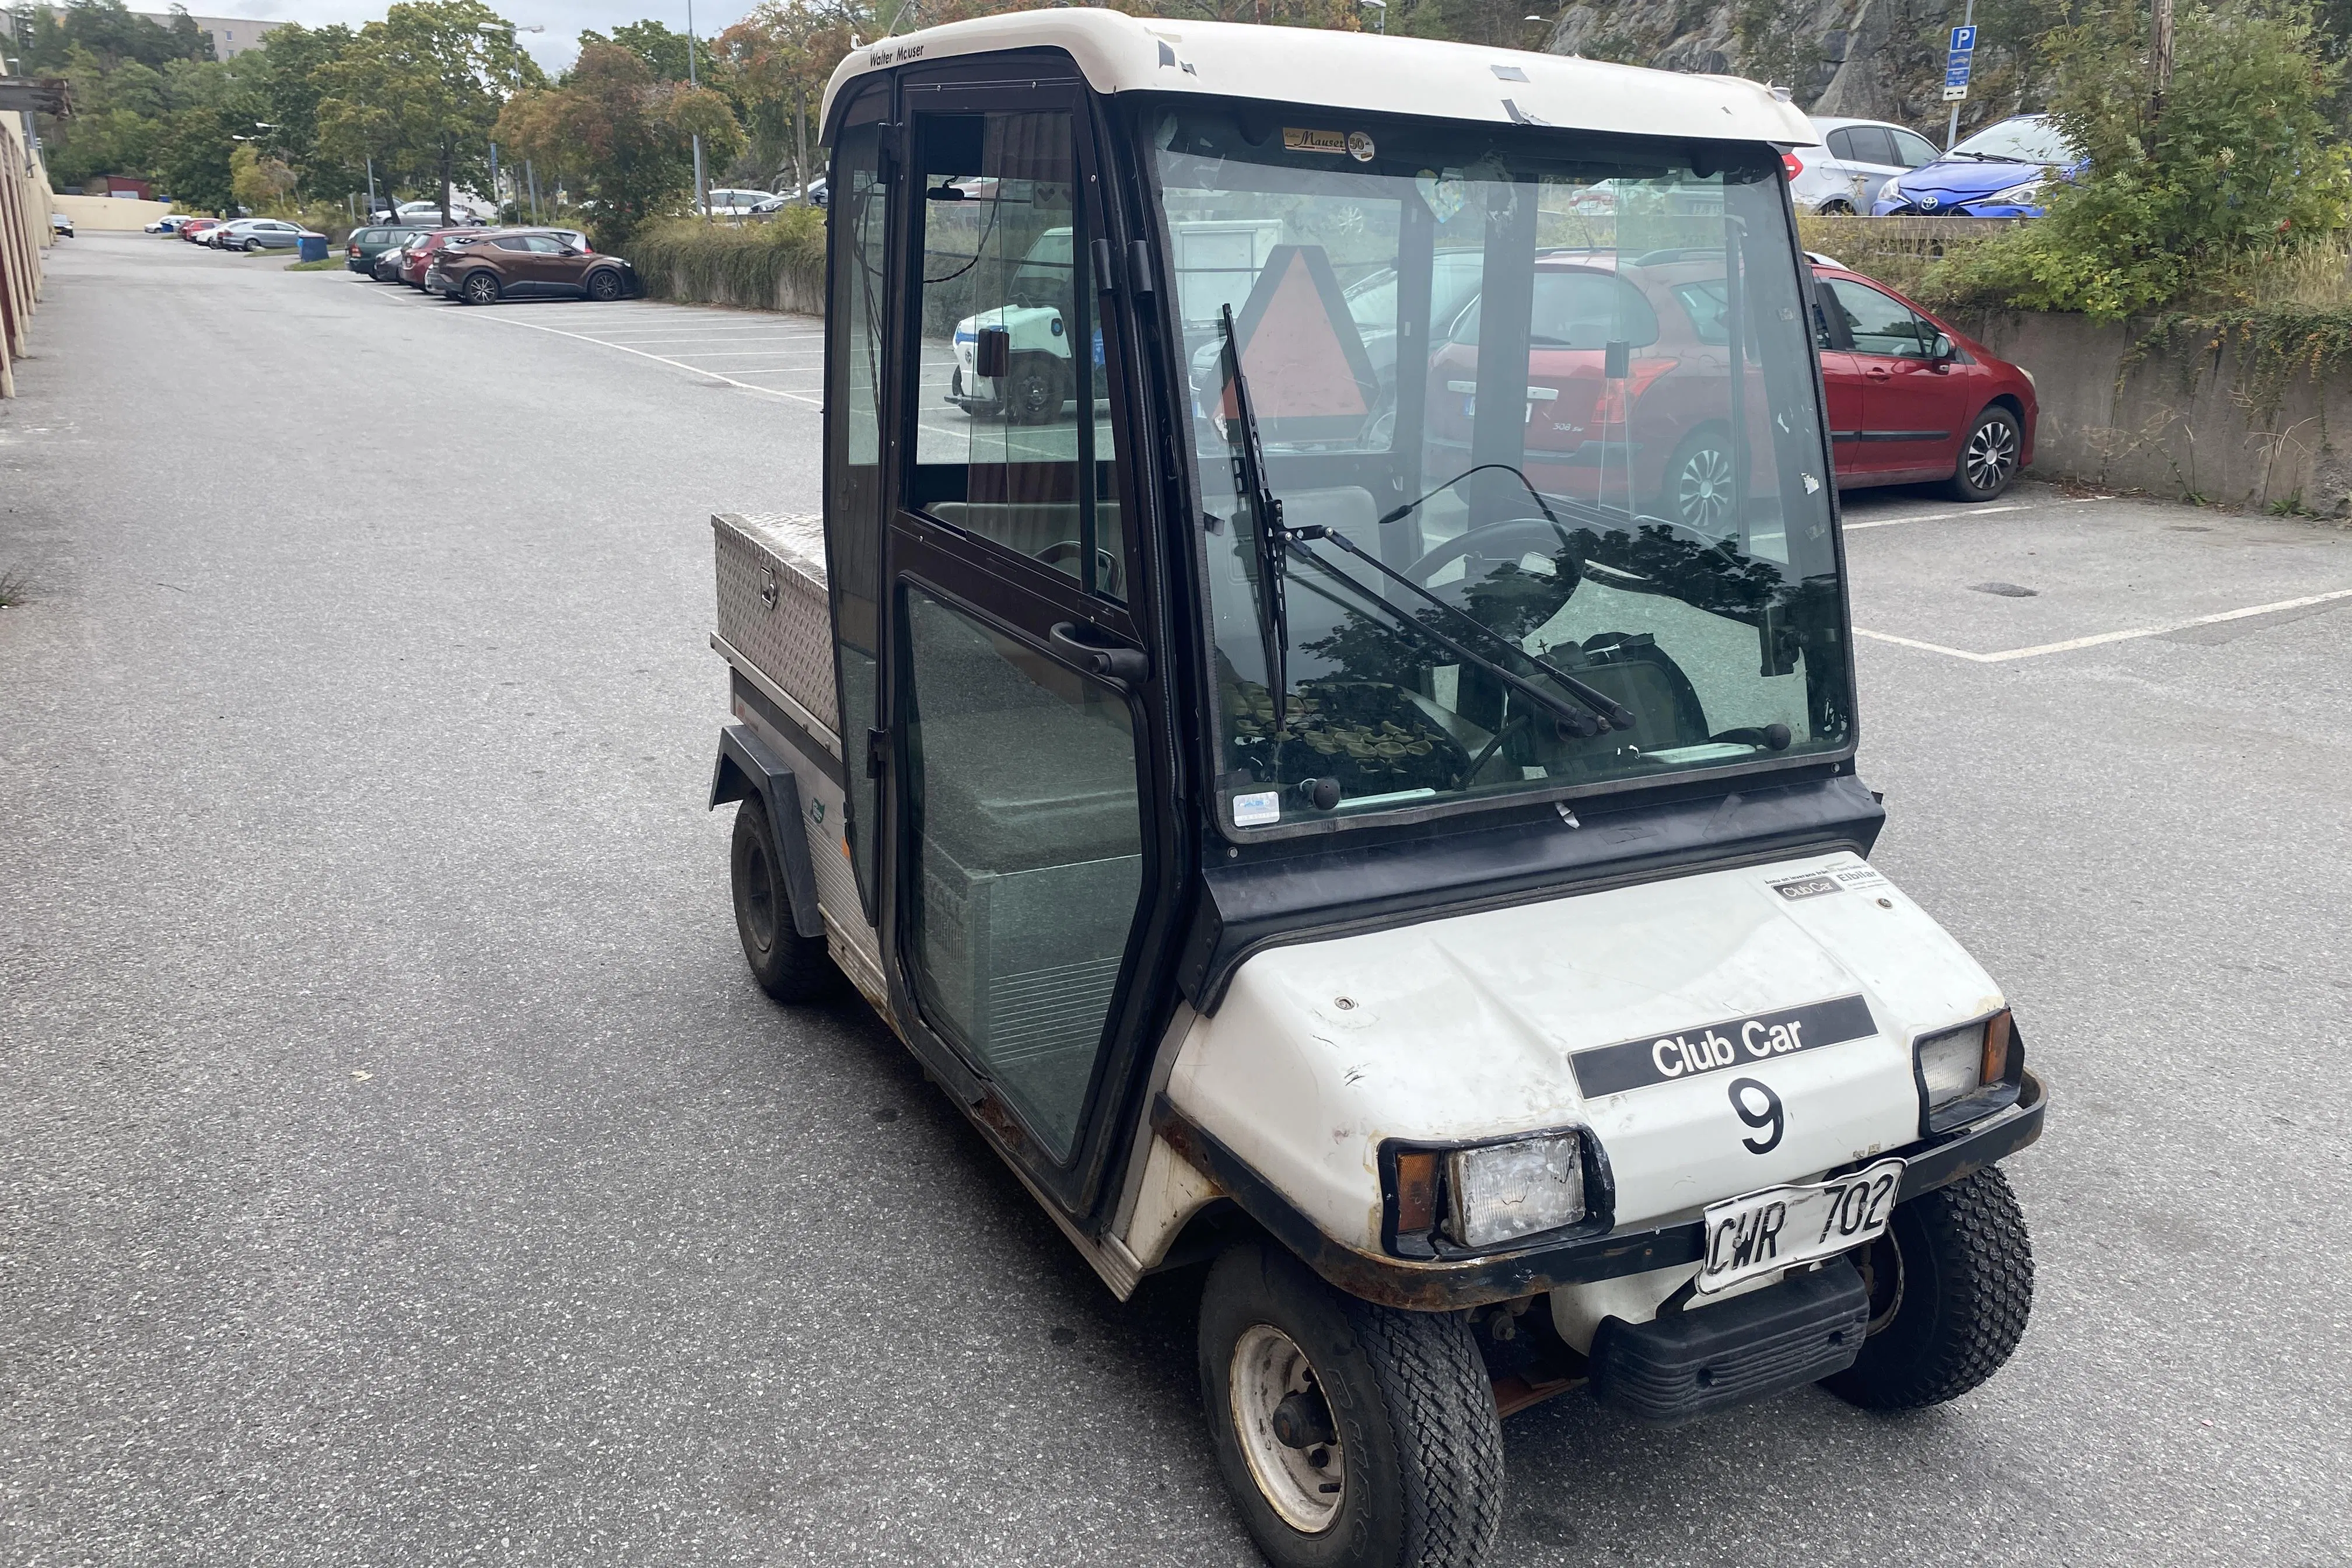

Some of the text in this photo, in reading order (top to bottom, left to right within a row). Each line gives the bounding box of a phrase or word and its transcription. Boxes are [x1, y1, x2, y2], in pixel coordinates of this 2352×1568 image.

[1957, 29, 1971, 48] P
[870, 50, 892, 67] Walter
[1294, 131, 1345, 148] Mauser
[1552, 422, 1572, 431] 308
[1836, 871, 1877, 881] Elbilar
[1652, 1020, 1802, 1077] Club Car
[1727, 1077, 1784, 1156] 9
[1707, 1173, 1894, 1276] CWR 702
